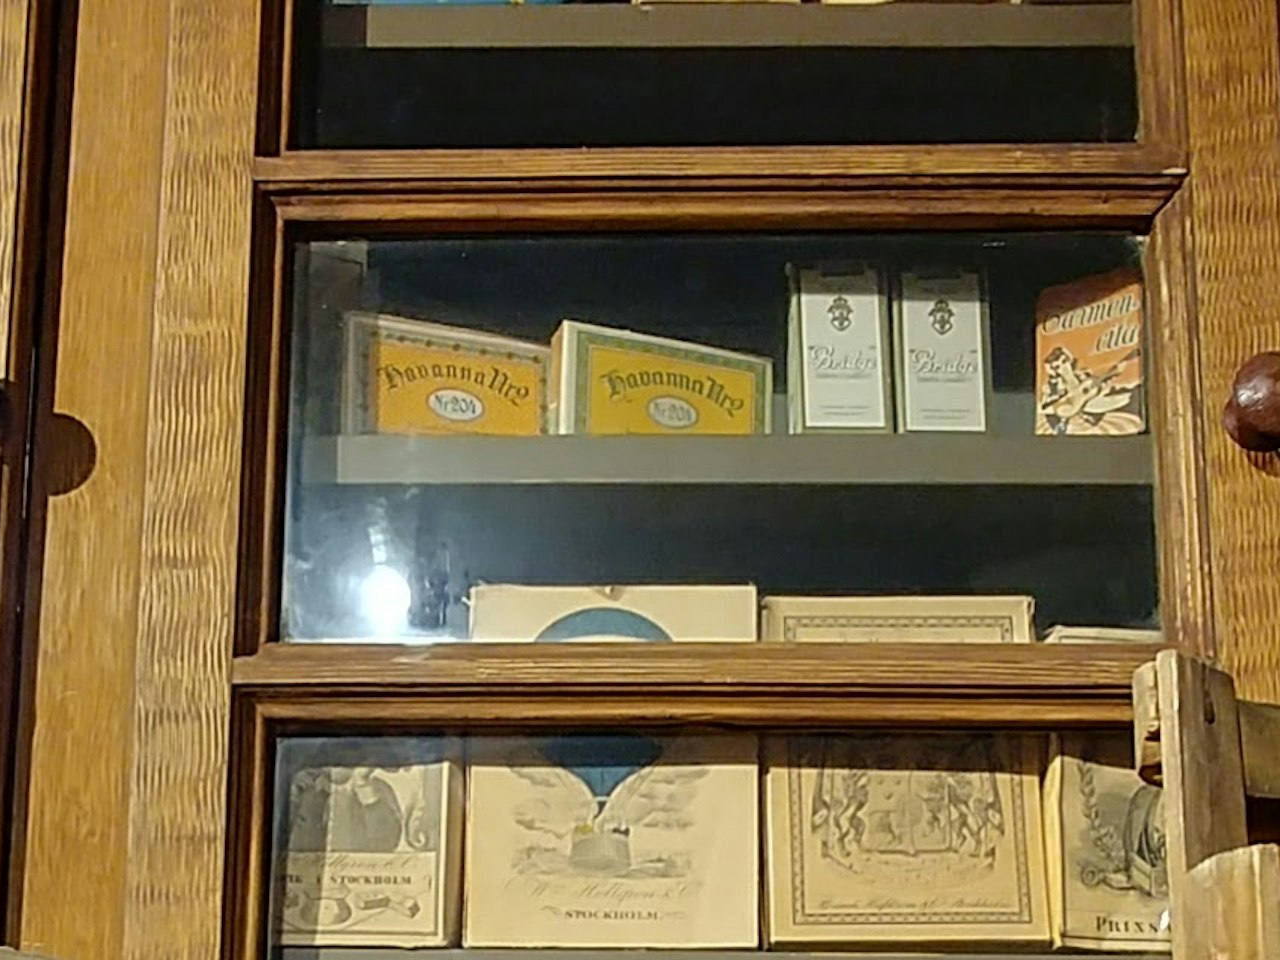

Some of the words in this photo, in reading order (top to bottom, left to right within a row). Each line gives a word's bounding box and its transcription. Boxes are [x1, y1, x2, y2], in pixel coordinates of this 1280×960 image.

[377, 363, 486, 392] Havanna
[600, 368, 706, 399] Havanna
[330, 875, 412, 886] STOCKHOLM
